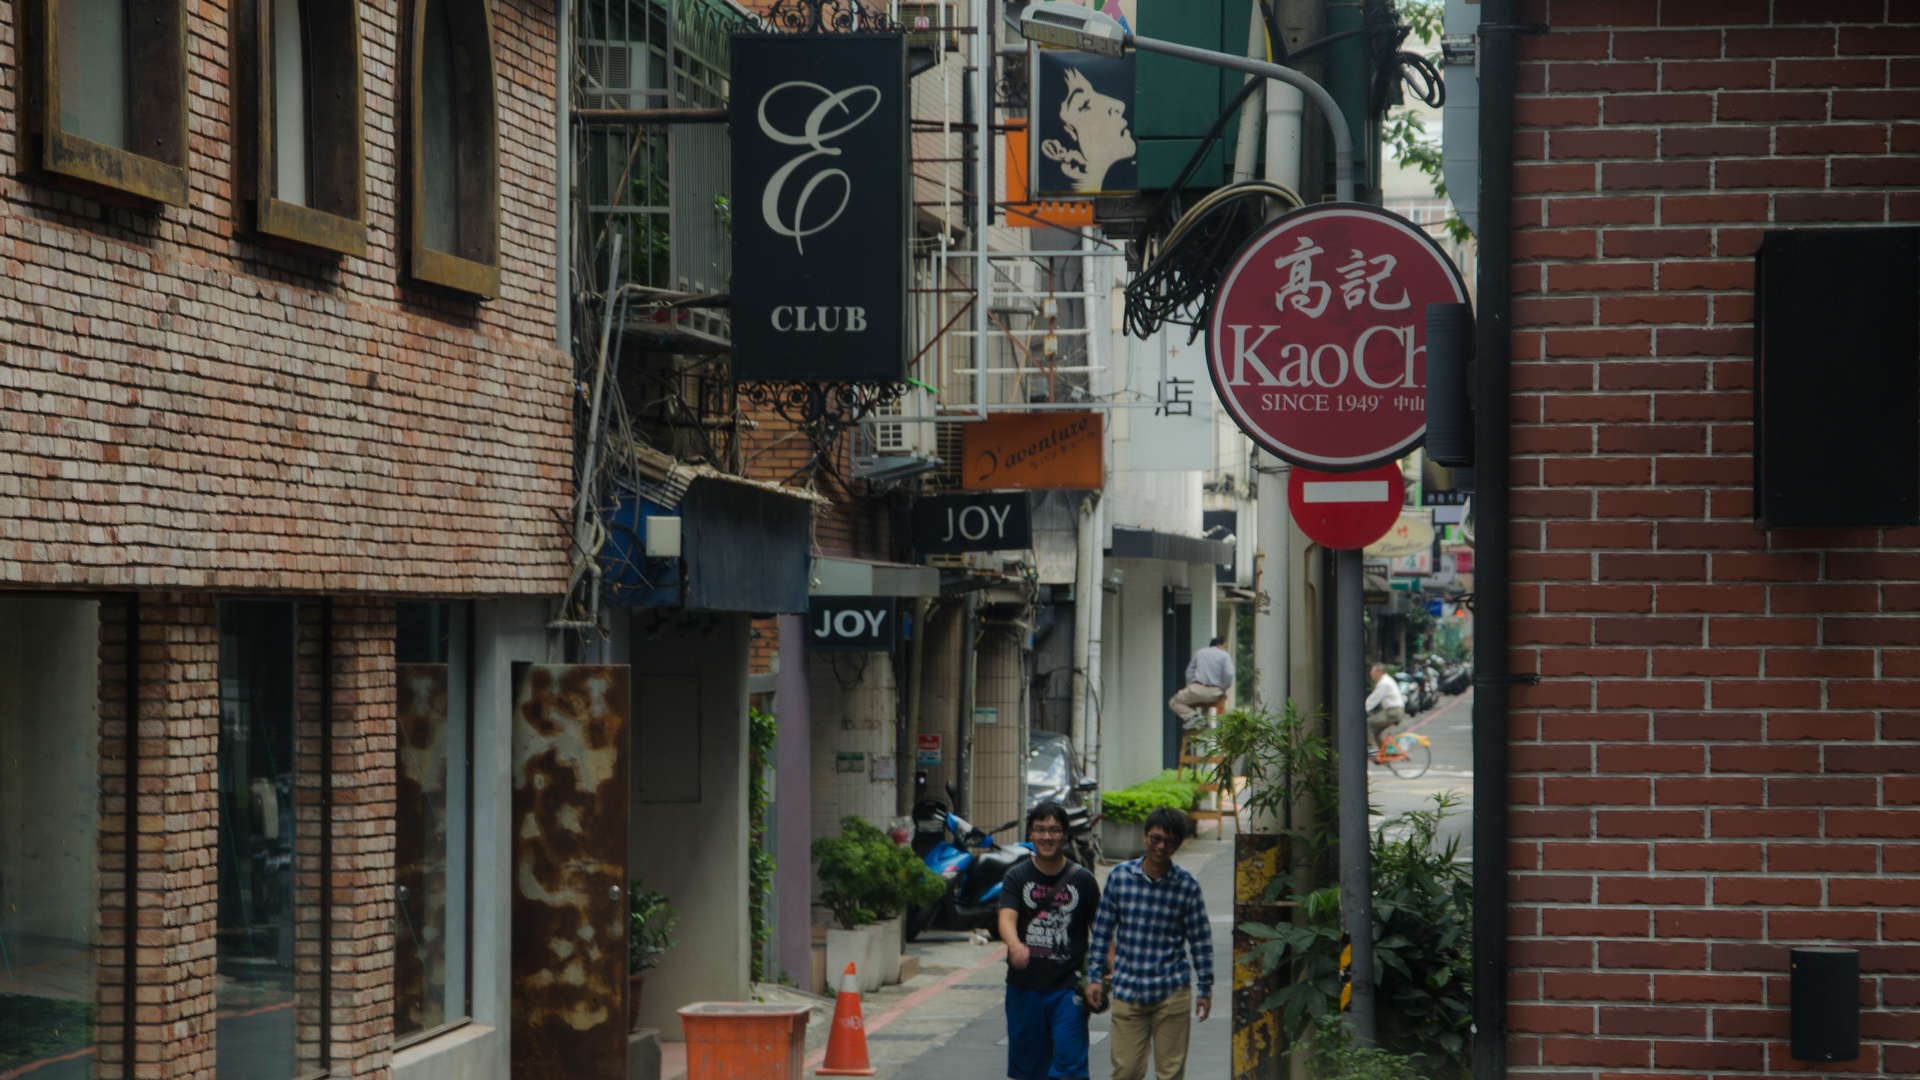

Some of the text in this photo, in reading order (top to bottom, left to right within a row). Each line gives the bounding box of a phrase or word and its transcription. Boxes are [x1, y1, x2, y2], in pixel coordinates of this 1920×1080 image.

[1274, 236, 1411, 319] 高記
[770, 305, 868, 333] CLUB
[1261, 393, 1330, 412] SINCE
[942, 504, 1012, 542] JOY
[814, 609, 887, 639] JOY
